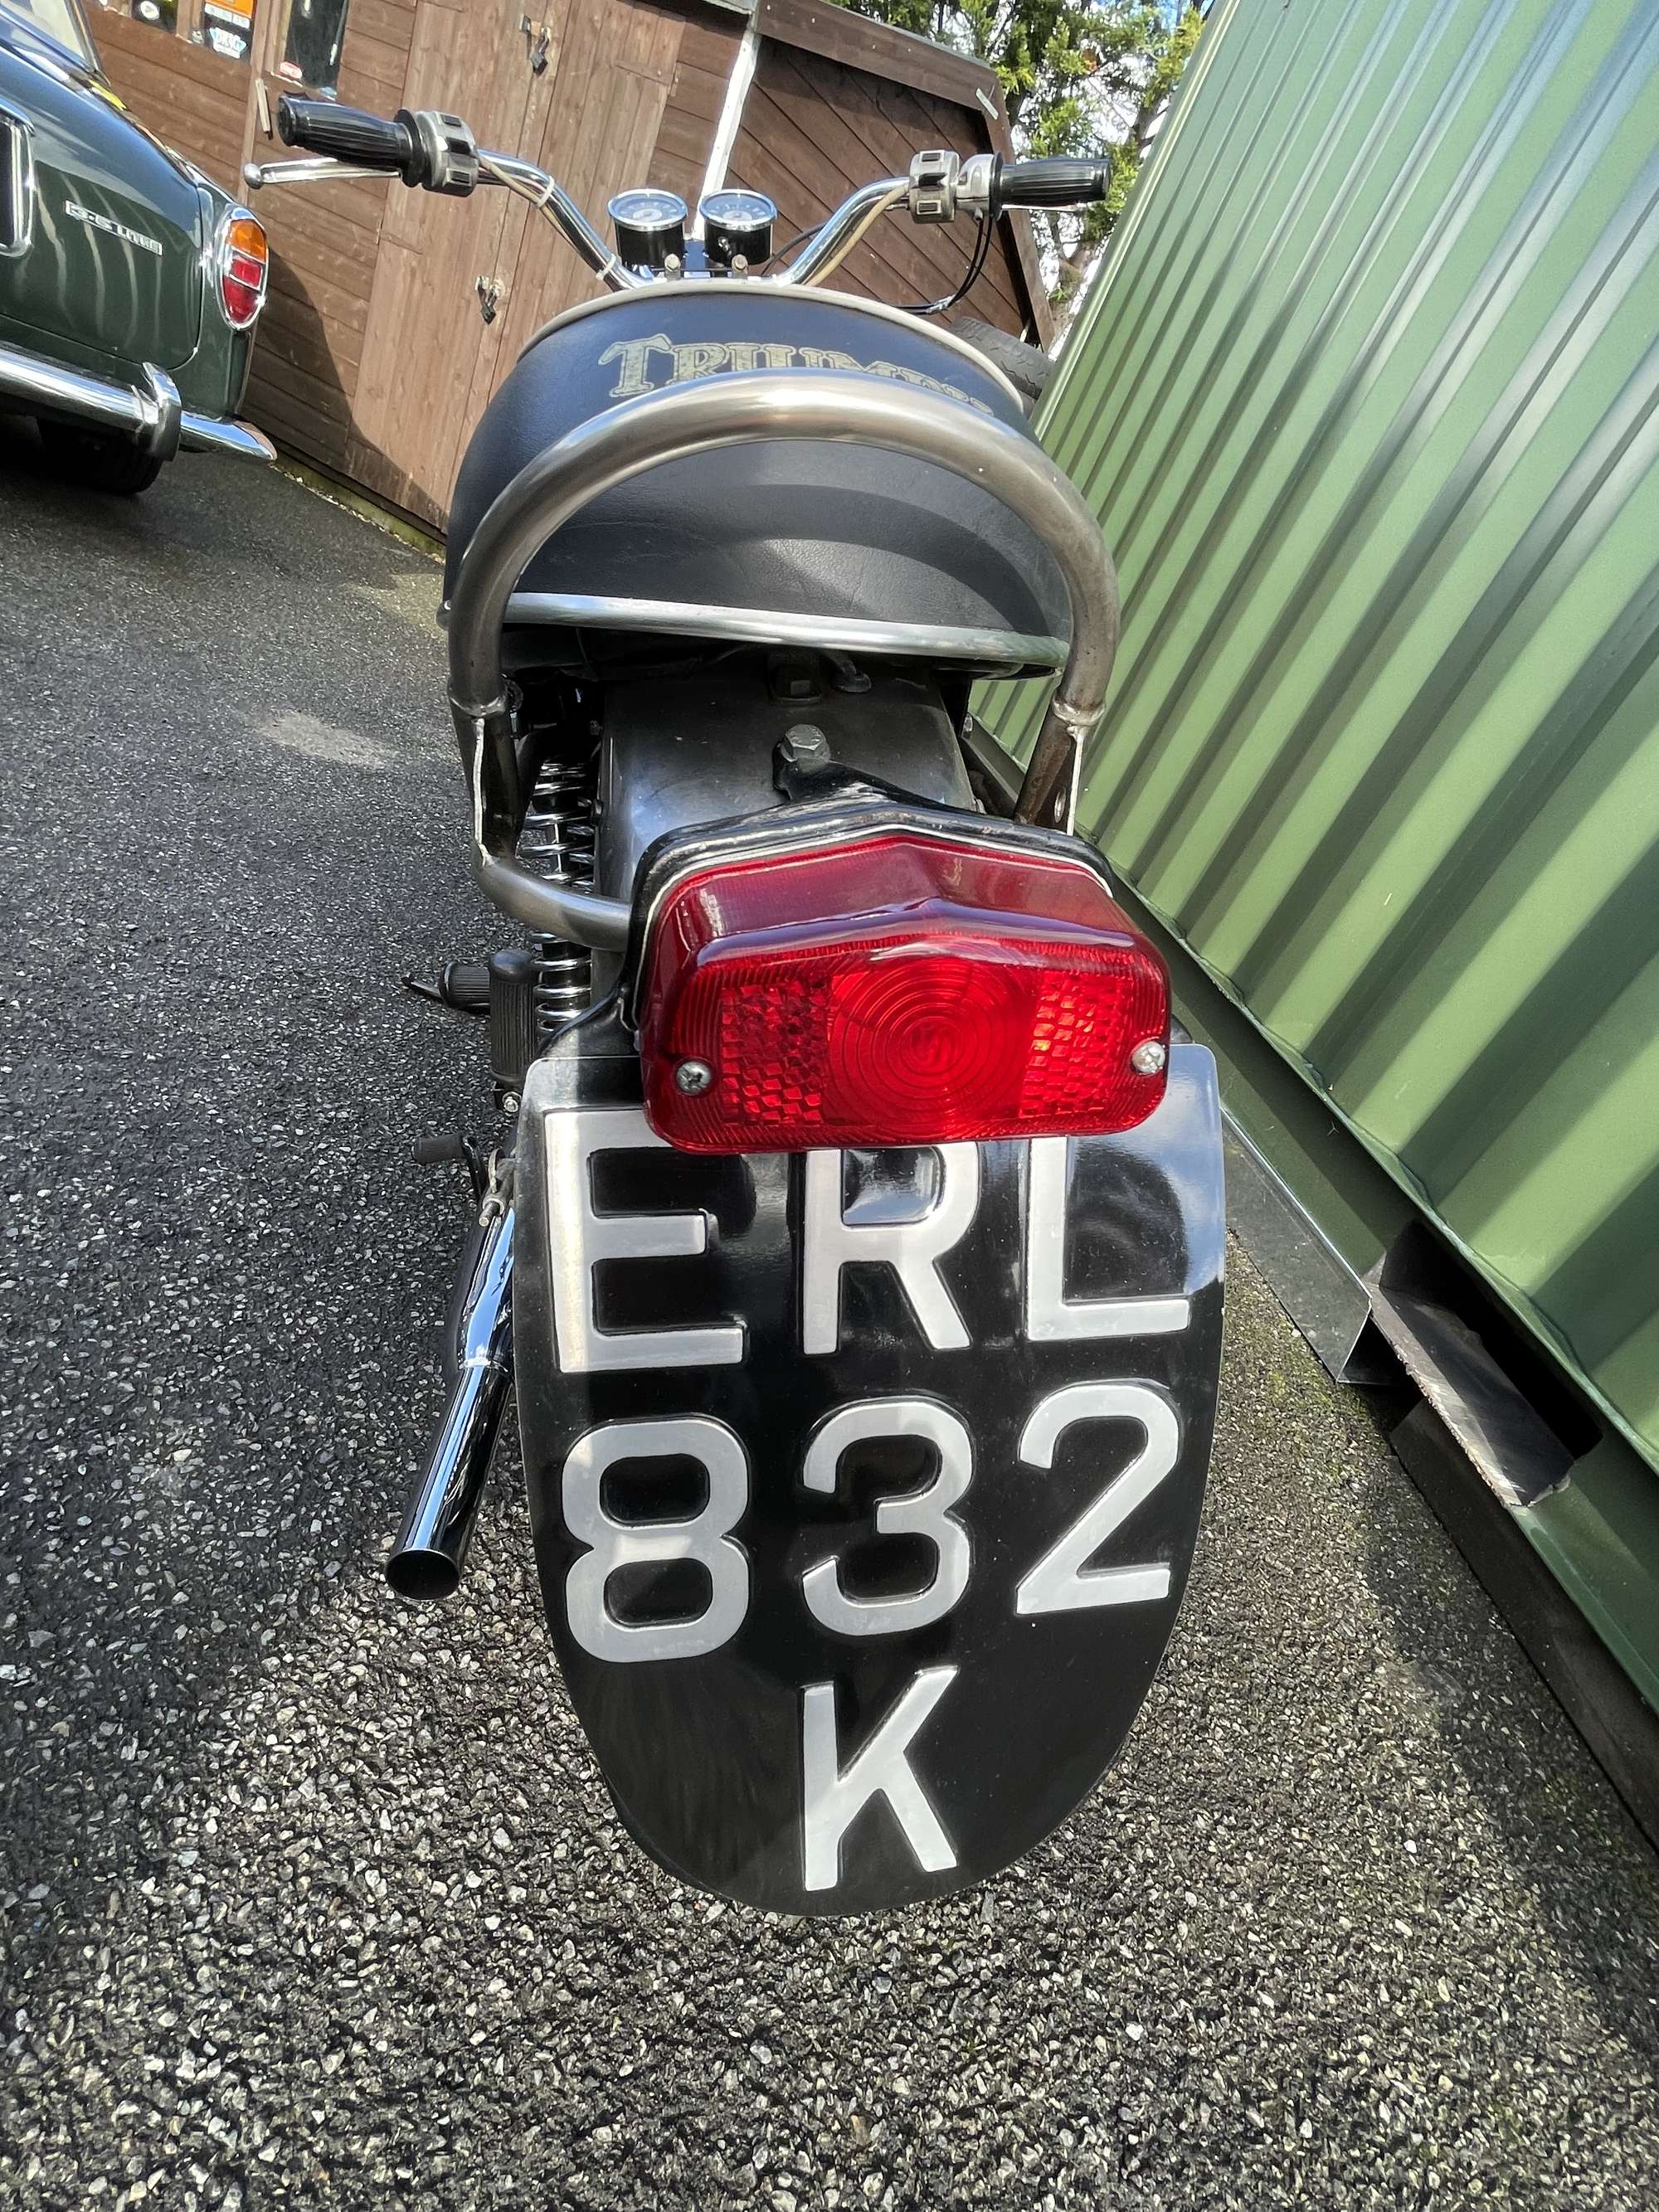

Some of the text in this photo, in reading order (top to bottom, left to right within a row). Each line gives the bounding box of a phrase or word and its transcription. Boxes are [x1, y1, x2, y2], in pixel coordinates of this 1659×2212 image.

[598, 333, 994, 416] TRIU
[544, 1109, 1191, 1373] ERL
[561, 1378, 1180, 1663] 832
[801, 1665, 959, 1892] K
